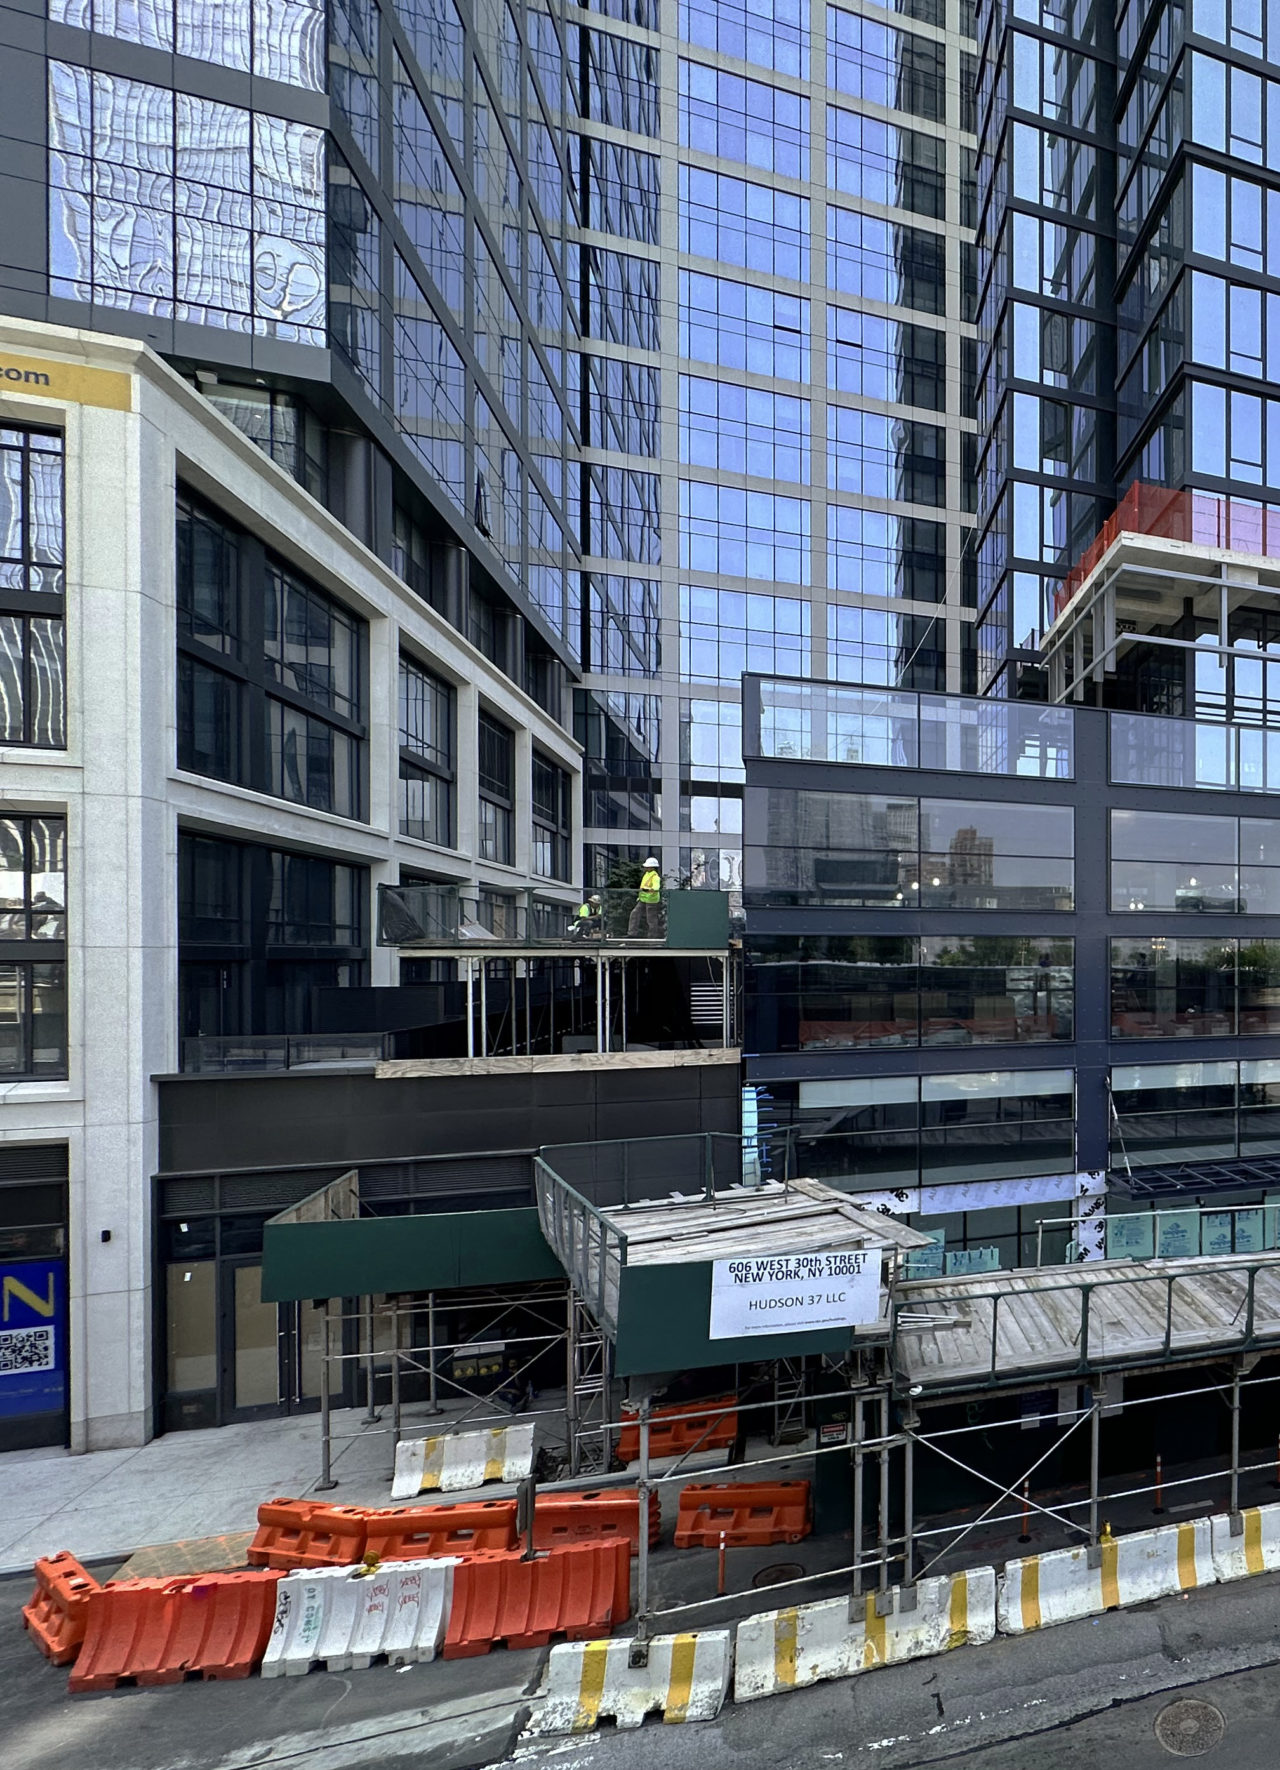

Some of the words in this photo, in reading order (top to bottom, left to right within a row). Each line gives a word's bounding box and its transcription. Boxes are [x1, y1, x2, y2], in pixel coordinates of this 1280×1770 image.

[0, 367, 50, 386] om
[728, 1261, 751, 1274] 606
[755, 1258, 791, 1271] WEST
[794, 1256, 822, 1269] 30th
[825, 1253, 868, 1266] STREET
[734, 1271, 764, 1284] NEW
[768, 1268, 804, 1282] YORK,
[807, 1266, 825, 1278] NY
[828, 1264, 862, 1276] 10001
[749, 1296, 804, 1311] HUDSON
[807, 1294, 822, 1306] 37
[826, 1292, 846, 1304] LLC
